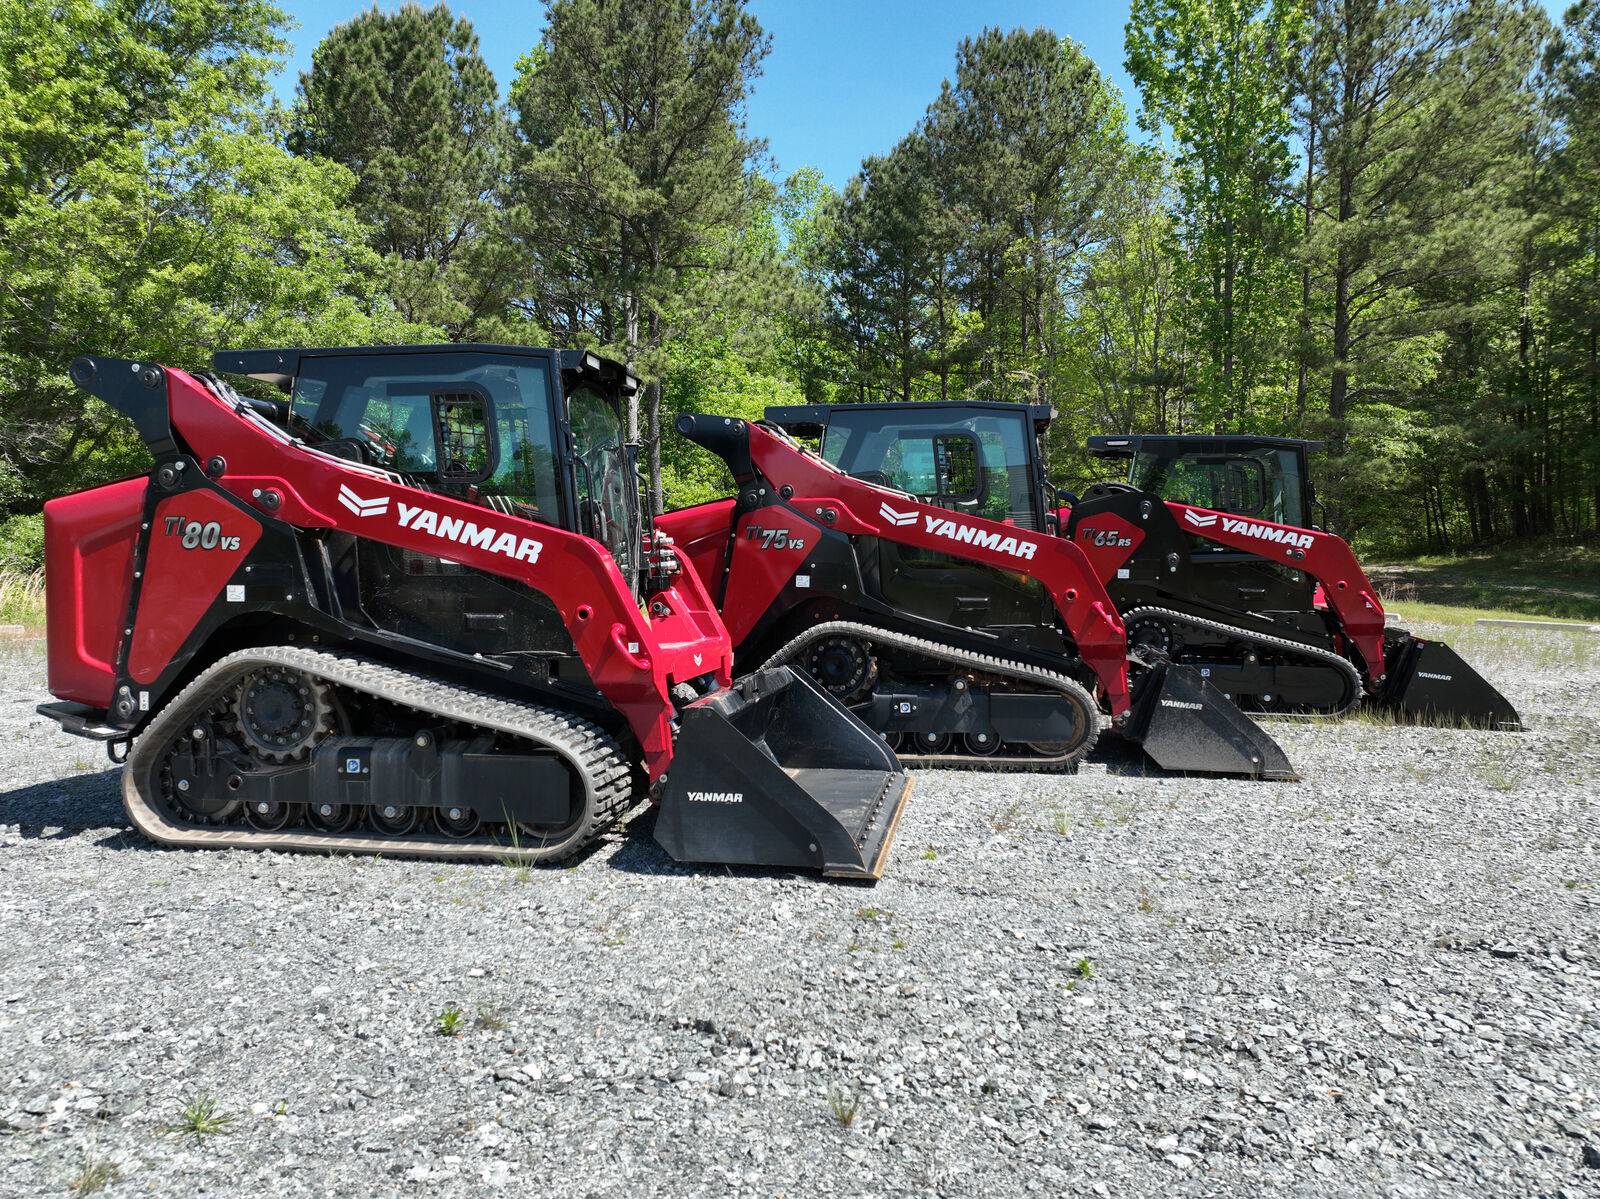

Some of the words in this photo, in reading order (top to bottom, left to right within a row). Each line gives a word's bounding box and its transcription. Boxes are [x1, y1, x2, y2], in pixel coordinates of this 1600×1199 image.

[397, 502, 543, 564] YANMAR
[925, 515, 1037, 560] YANMAR
[1222, 517, 1315, 549] YANMAR
[1417, 671, 1452, 681] YANMAR
[1160, 699, 1203, 710] YANMAR
[687, 791, 743, 803] YANMAR
